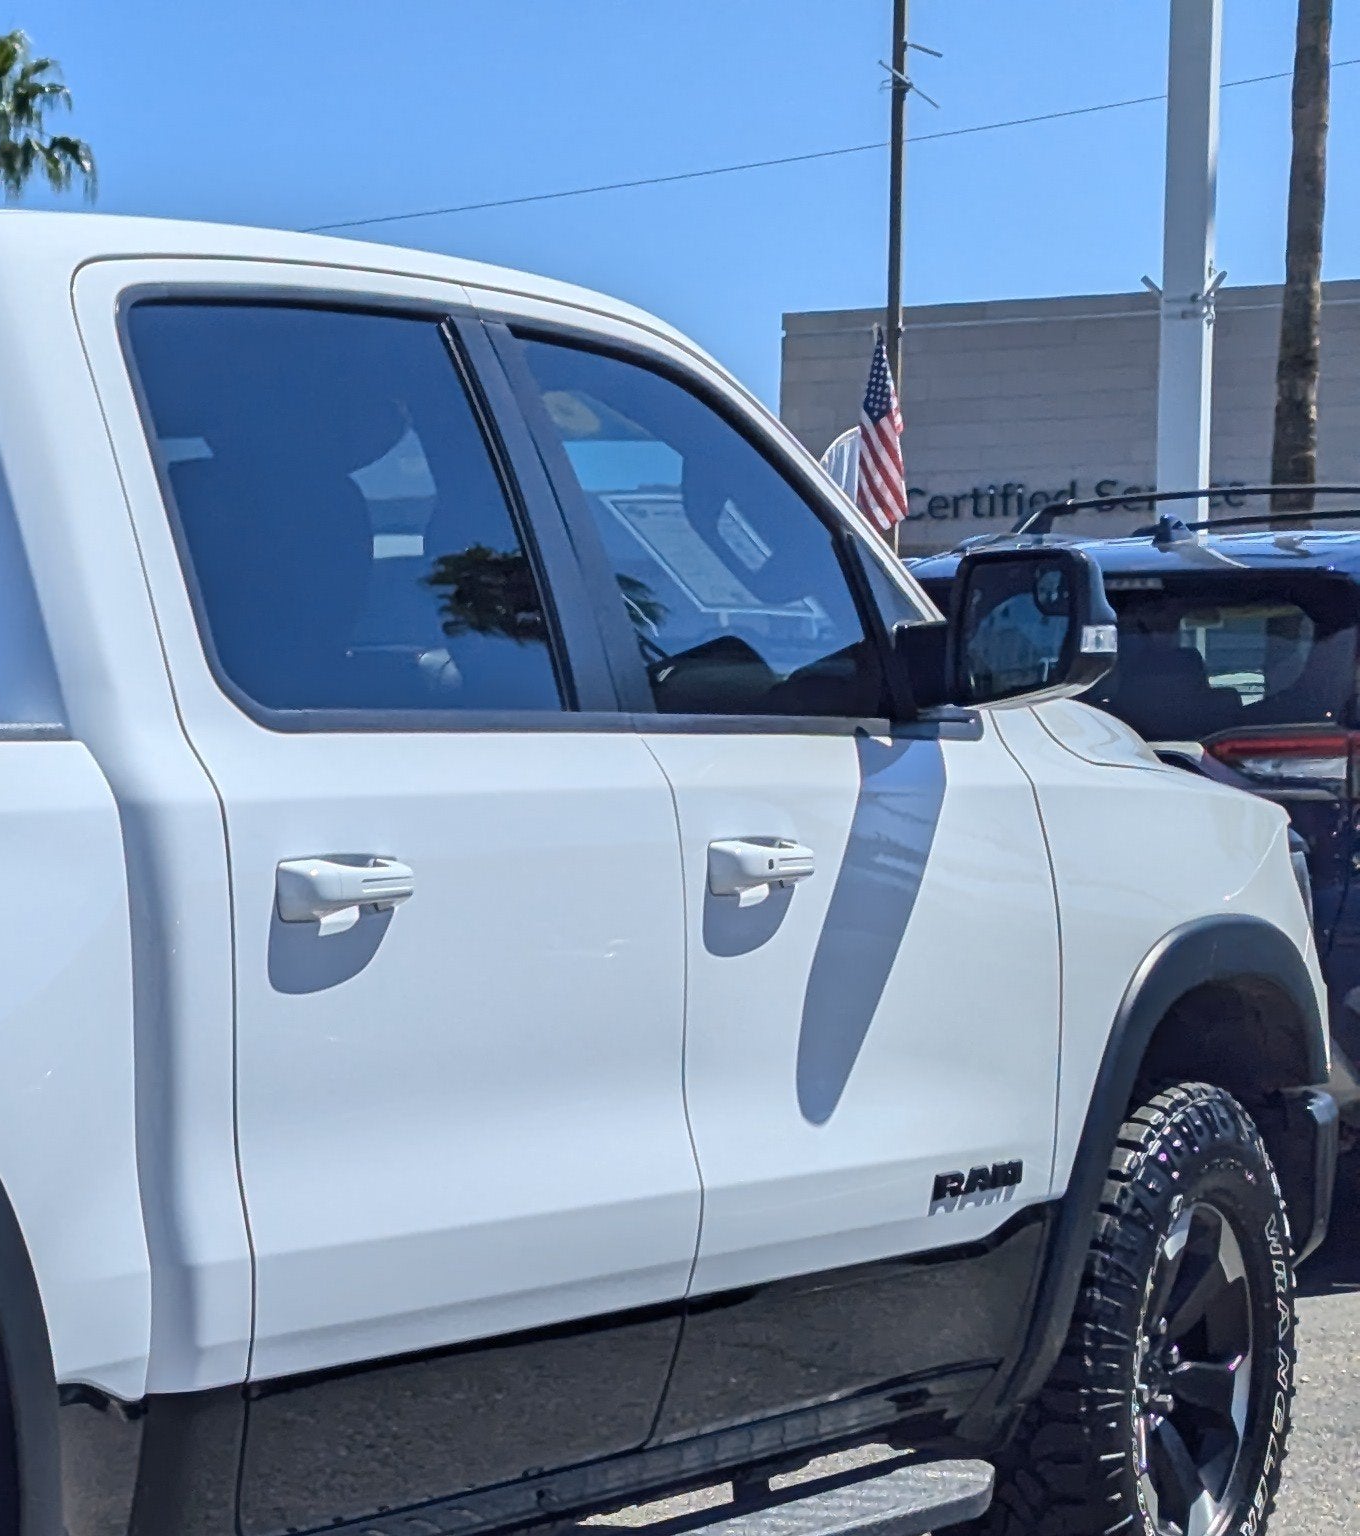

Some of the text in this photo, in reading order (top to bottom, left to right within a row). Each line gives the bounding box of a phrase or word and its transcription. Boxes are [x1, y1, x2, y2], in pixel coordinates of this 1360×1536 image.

[904, 478, 1245, 521] Certified Serce
[931, 1158, 1024, 1203] RAM
